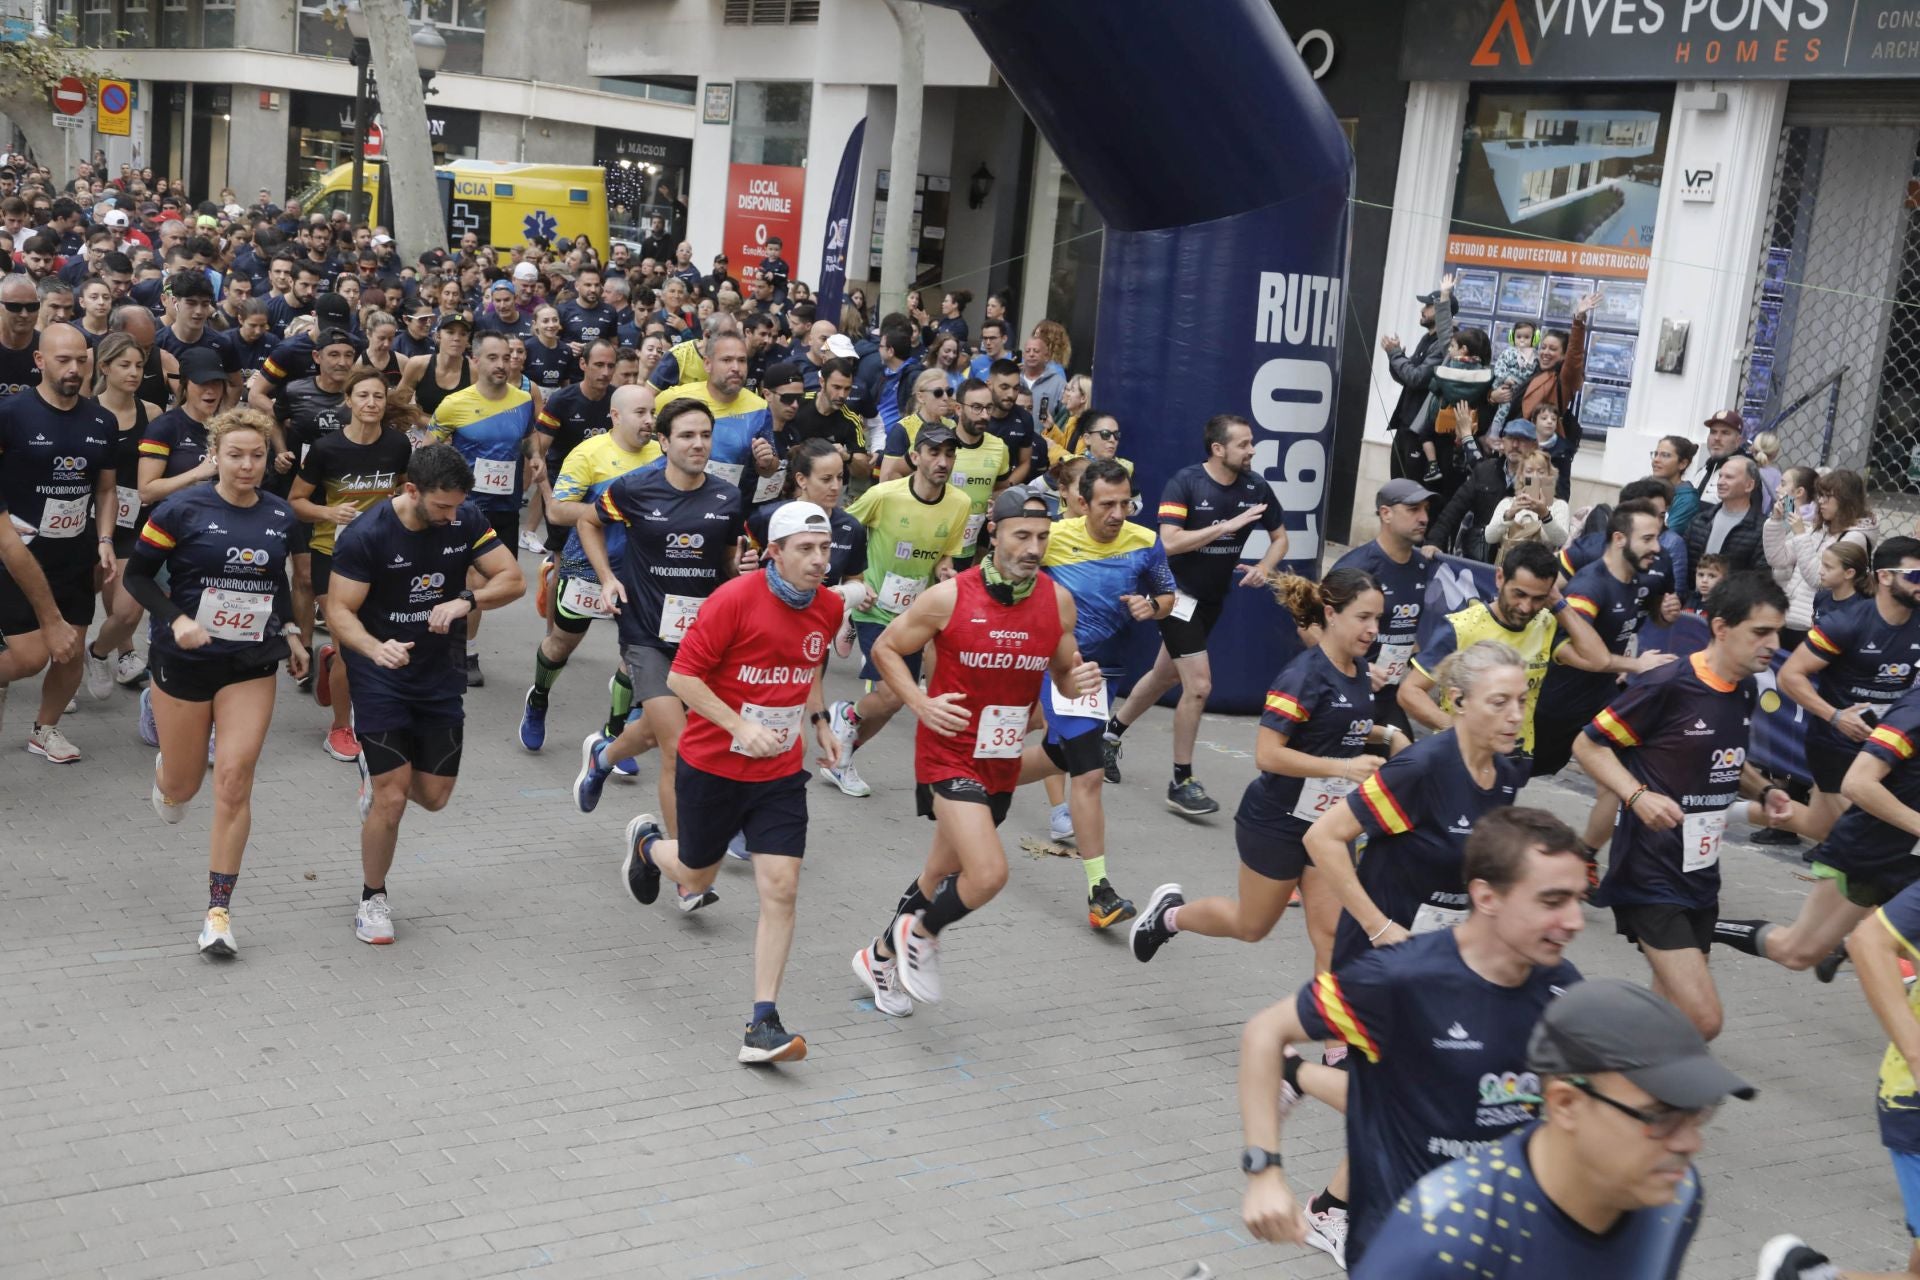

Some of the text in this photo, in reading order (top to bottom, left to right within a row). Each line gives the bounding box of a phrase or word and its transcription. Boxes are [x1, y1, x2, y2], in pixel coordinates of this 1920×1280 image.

[1535, 0, 1828, 38] VIVES PONS
[1675, 38, 1822, 63] HOMES
[628, 143, 667, 157] MACSON
[750, 179, 779, 195] LOCAL
[1685, 169, 1713, 187] VP
[738, 195, 791, 213] DISPONIBLE
[1450, 241, 1485, 255] ESTUDIO
[1487, 245, 1498, 258] DE
[1501, 247, 1567, 264] ARQUITECTURA
[1571, 253, 1577, 264] Y
[1255, 271, 1341, 348] RUTA
[484, 474, 508, 487] 142
[666, 533, 704, 549] 200
[226, 547, 269, 565] 200
[410, 573, 445, 592] 200
[213, 610, 255, 629] 542
[989, 630, 1028, 640] excom
[959, 651, 1049, 671] NUCLEO DURO
[737, 664, 790, 685] NUCLEO
[1711, 747, 1745, 770] 200
